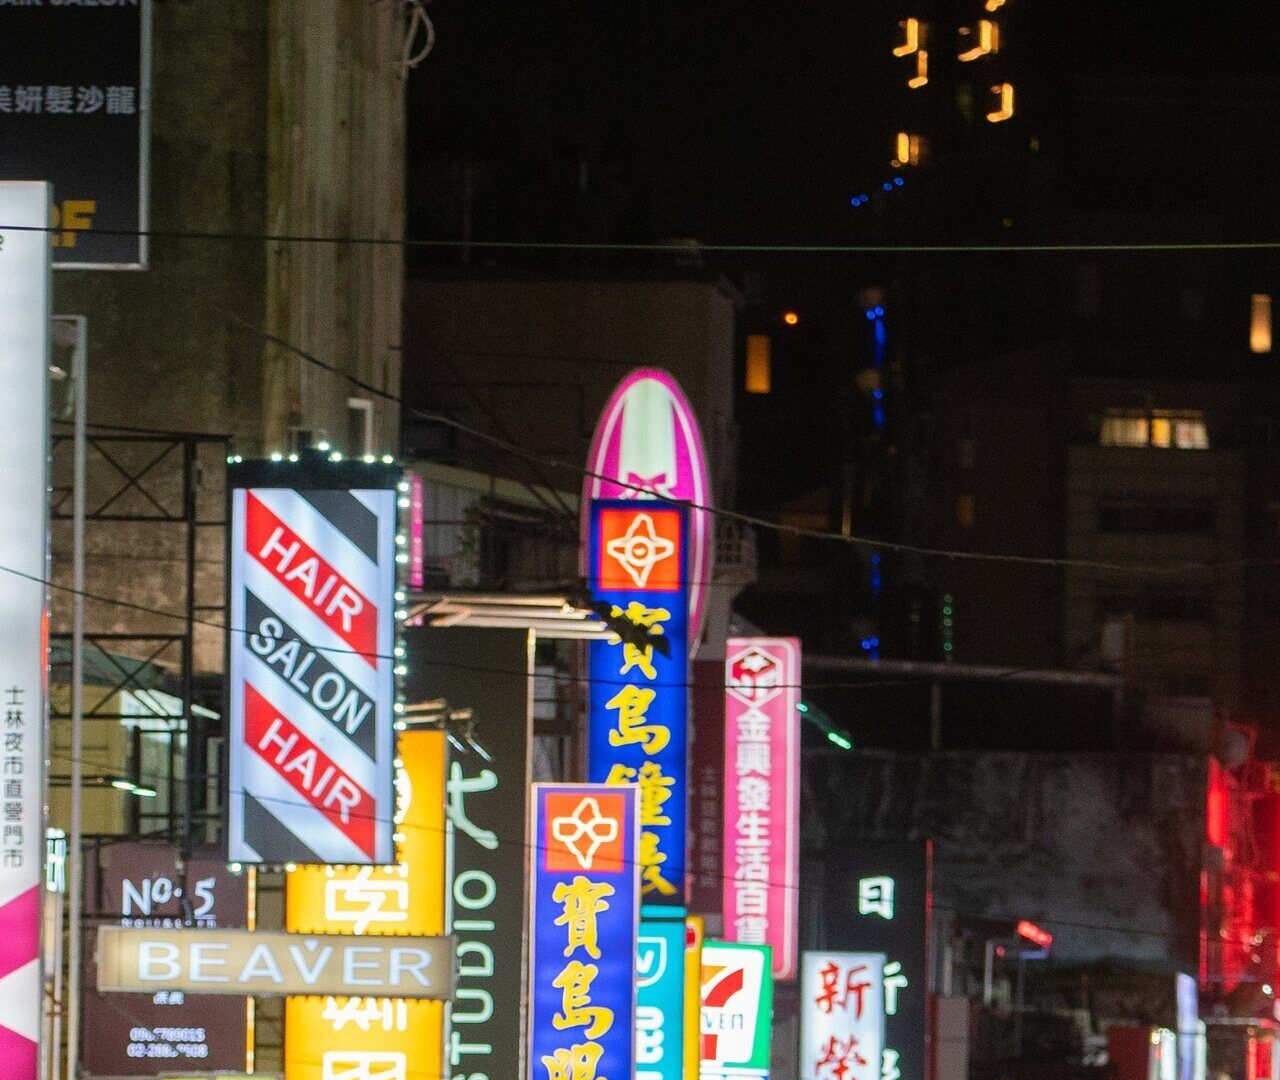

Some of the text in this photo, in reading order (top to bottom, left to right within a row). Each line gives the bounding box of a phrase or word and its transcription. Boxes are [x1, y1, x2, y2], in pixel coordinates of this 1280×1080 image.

[259, 525, 365, 634] HAIR
[250, 615, 372, 737] SALON
[257, 717, 363, 827] HAIR
[136, 940, 433, 988] BEAVER
